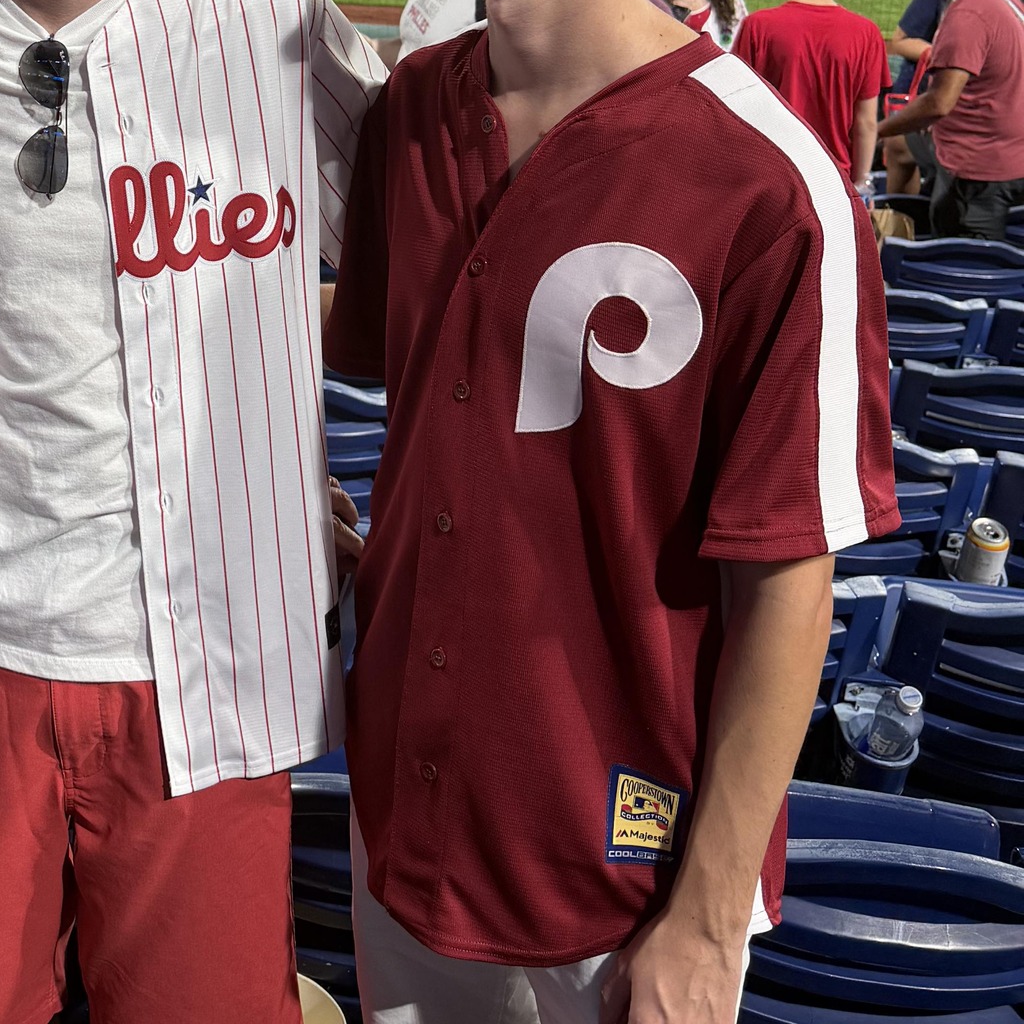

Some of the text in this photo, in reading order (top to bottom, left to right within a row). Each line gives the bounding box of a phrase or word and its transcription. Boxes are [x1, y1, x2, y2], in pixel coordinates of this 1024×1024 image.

[514, 242, 704, 434] P
[620, 778, 676, 815] COOPERSTOWN
[621, 811, 668, 825] COLLECTION
[630, 830, 670, 845] Majestic
